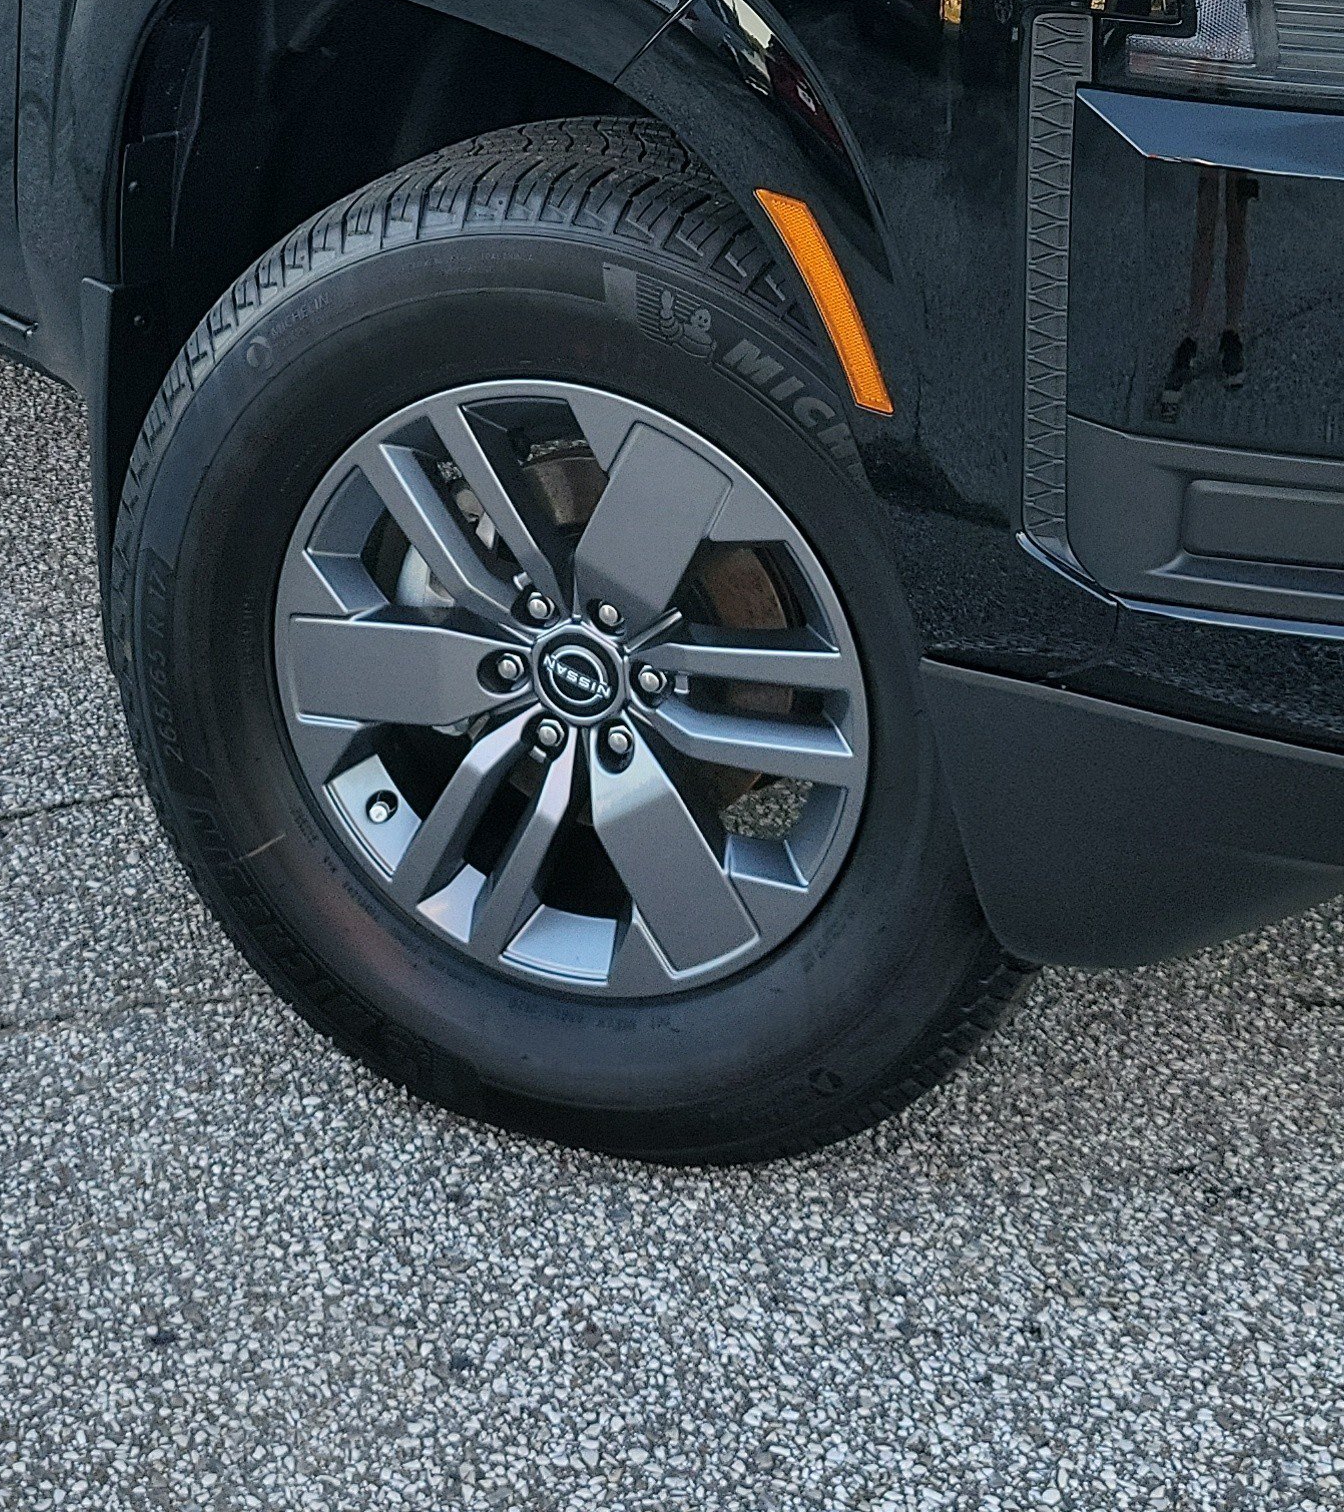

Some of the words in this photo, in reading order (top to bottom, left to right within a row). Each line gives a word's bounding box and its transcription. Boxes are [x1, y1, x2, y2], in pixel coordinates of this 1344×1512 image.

[722, 338, 864, 486] MICH
[146, 568, 167, 601] 17
[146, 613, 165, 638] R
[542, 653, 611, 699] NISSAN
[148, 644, 185, 764] 265/65
